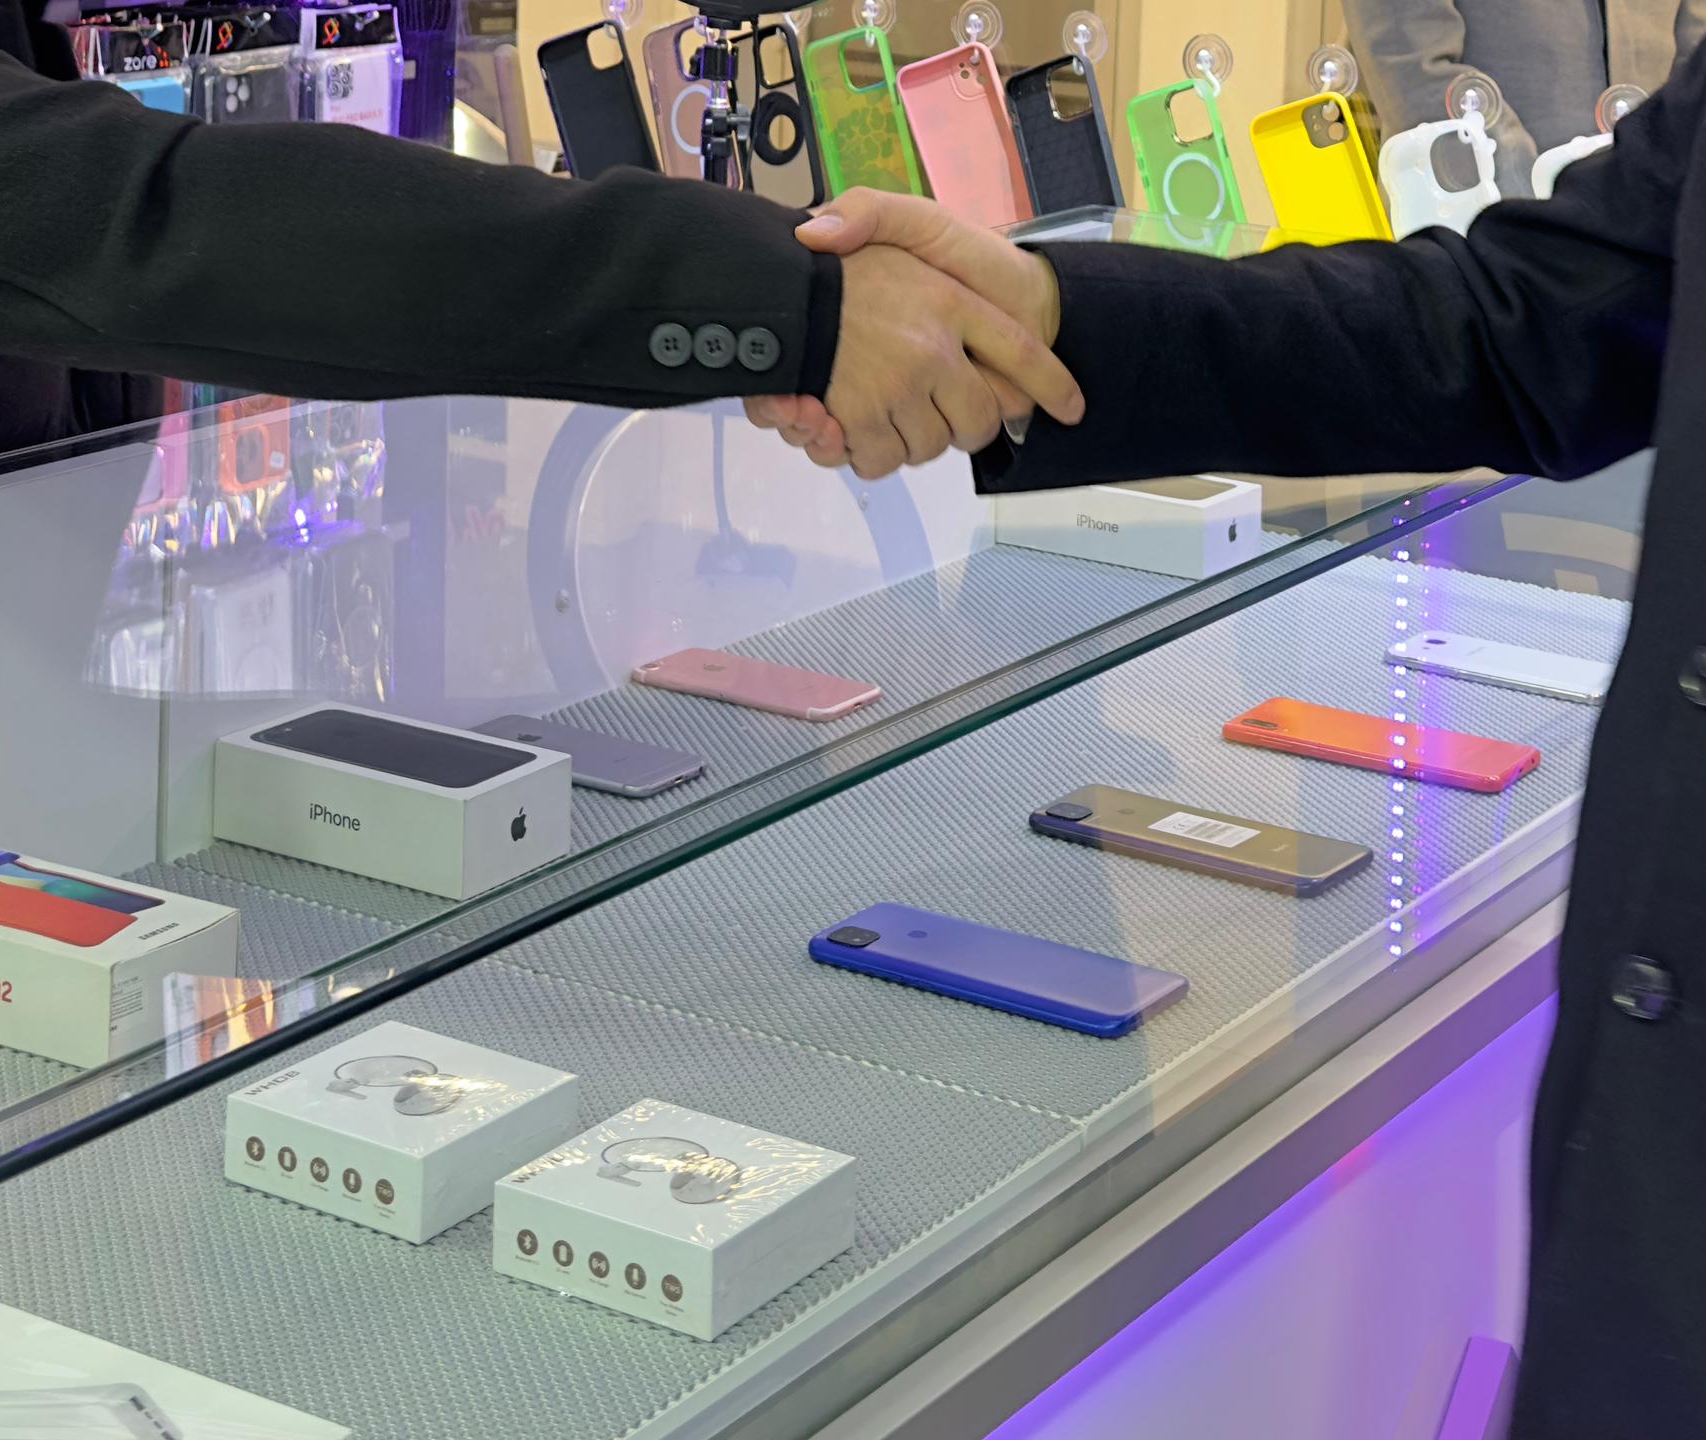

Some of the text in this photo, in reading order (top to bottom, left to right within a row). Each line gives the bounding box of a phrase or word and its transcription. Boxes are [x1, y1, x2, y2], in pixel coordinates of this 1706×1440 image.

[123, 54, 157, 72] zore
[1076, 513, 1120, 534] iPhone
[309, 802, 361, 831] iPhone
[138, 921, 180, 941] SAMSUNG
